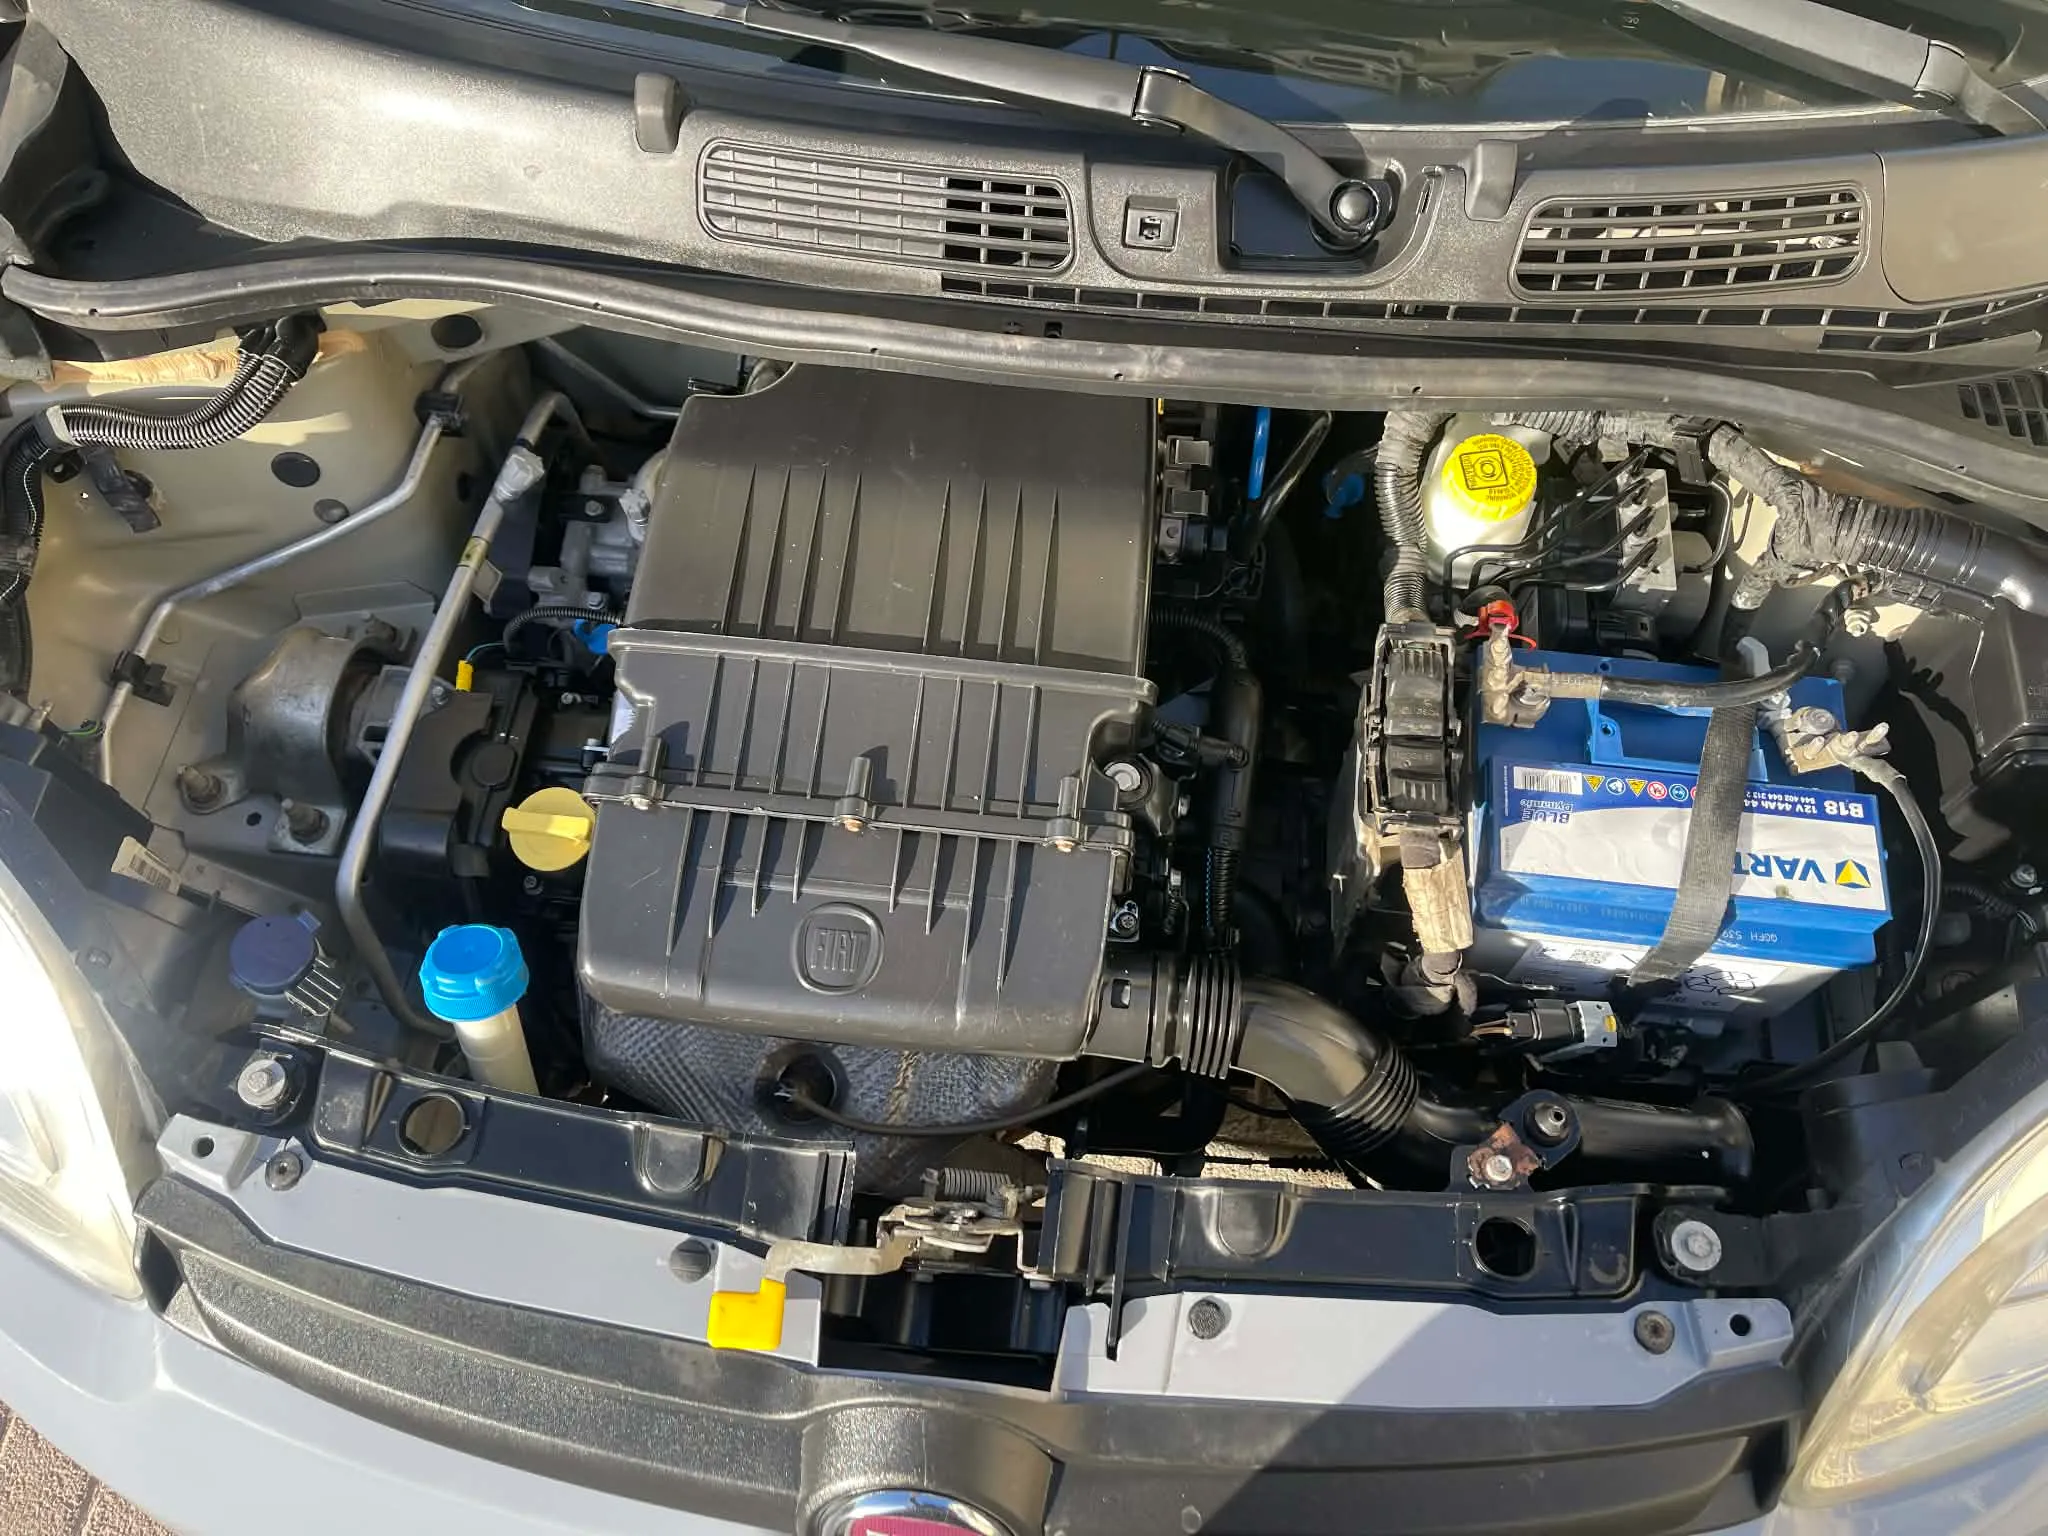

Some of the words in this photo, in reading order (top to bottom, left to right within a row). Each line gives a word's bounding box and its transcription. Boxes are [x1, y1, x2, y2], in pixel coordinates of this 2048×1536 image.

[1743, 798, 1759, 808] 44
[1760, 799, 1793, 811] 44Ah
[1795, 803, 1818, 814] 12V
[1823, 799, 1865, 819] B18
[1522, 807, 1571, 824] BLUE
[1733, 852, 1828, 884] VART
[809, 928, 867, 972] FIAT
